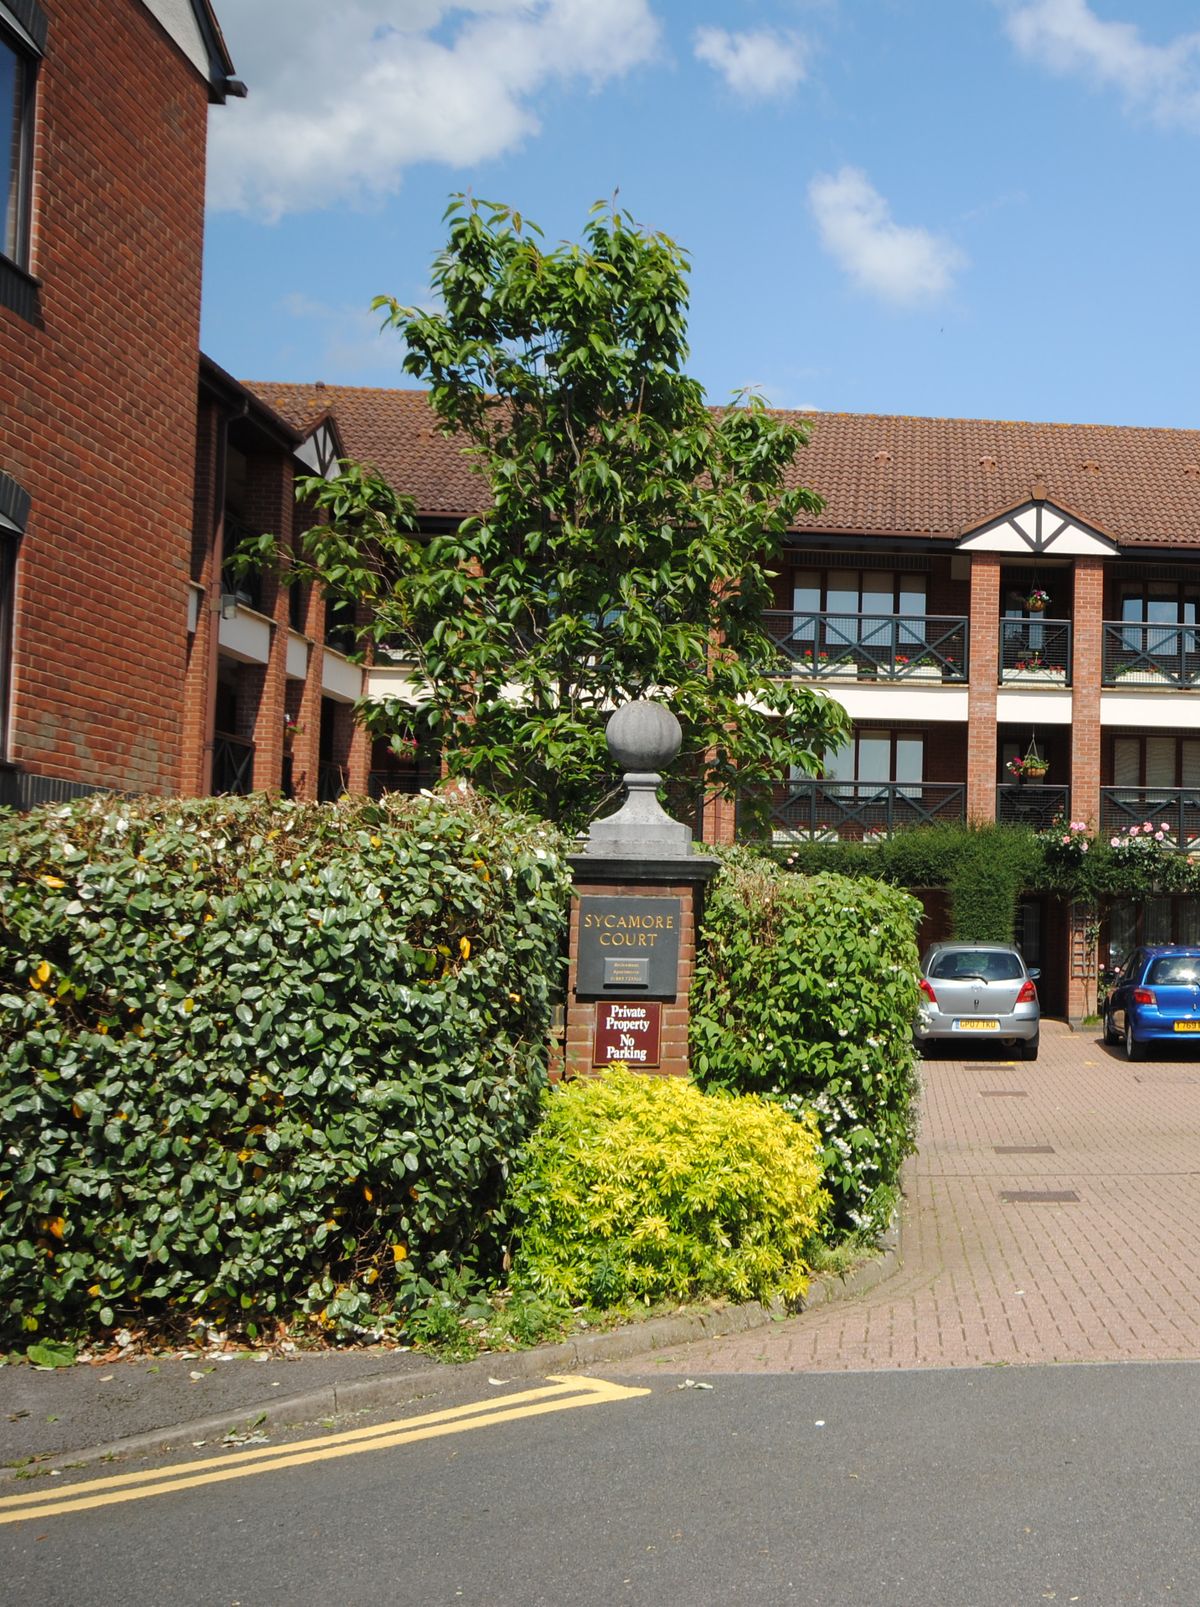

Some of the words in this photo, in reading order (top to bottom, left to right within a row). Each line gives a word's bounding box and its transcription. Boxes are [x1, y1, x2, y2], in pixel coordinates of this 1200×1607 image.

[584, 914, 674, 929] SYCAMORE
[599, 932, 658, 946] COURT
[611, 1005, 646, 1018] Private
[605, 1017, 650, 1032] Property
[619, 1033, 635, 1047] No
[606, 1046, 647, 1061] Parking
